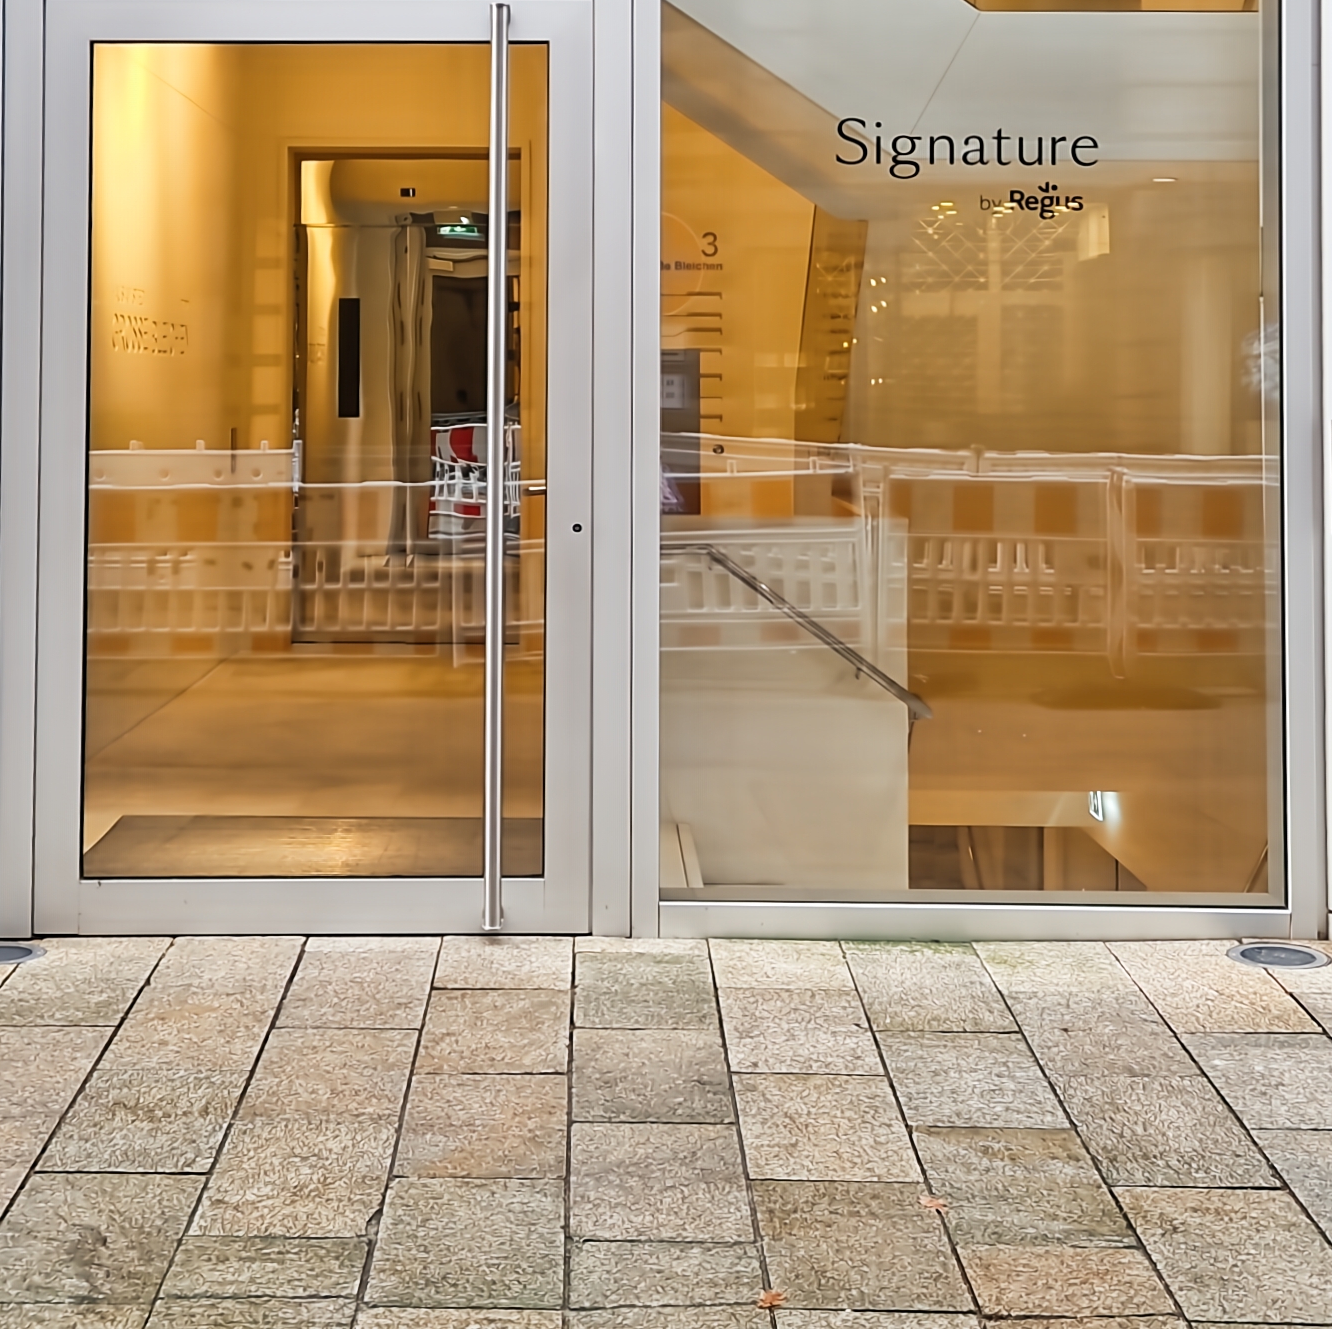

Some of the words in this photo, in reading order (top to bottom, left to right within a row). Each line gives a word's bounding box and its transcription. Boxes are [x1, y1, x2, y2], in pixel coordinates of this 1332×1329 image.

[835, 117, 1099, 180] Signature
[1009, 181, 1084, 220] Regus
[701, 231, 719, 258] 3
[674, 261, 723, 271] Bleichen
